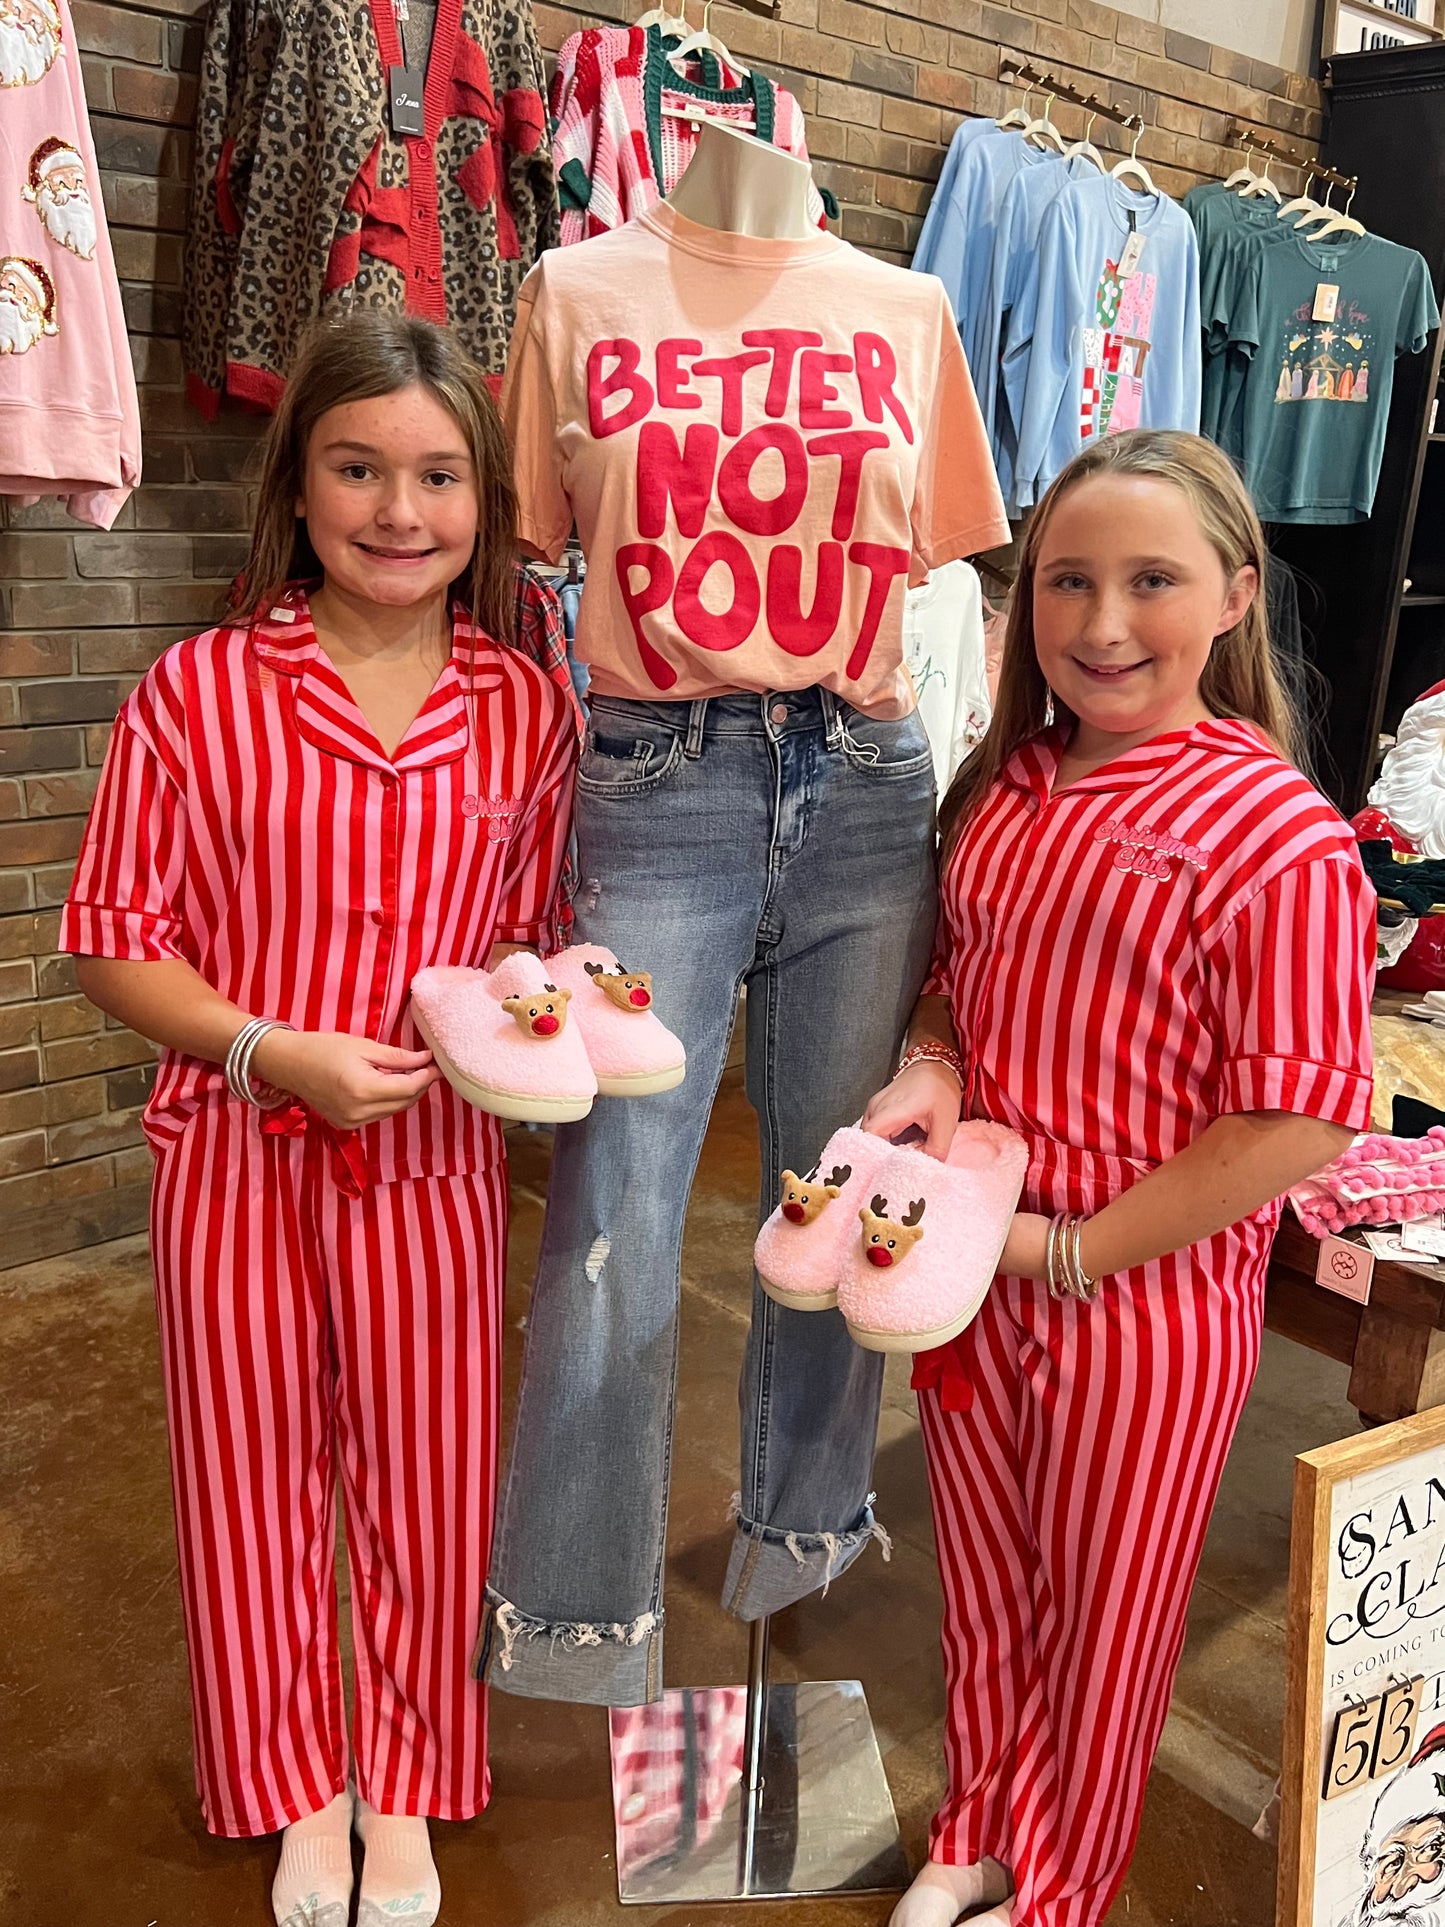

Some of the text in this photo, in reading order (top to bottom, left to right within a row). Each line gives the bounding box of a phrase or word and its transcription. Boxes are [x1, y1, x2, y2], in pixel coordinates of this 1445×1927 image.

[586, 328, 914, 445] BETTER
[636, 421, 890, 542] NOT
[615, 530, 910, 691] POUT
[1094, 819, 1211, 871] Christmas
[1113, 845, 1173, 883] Club
[1330, 1669, 1345, 1688] IS
[1353, 1635, 1423, 1677] COMING
[1334, 1697, 1415, 1786] 53
